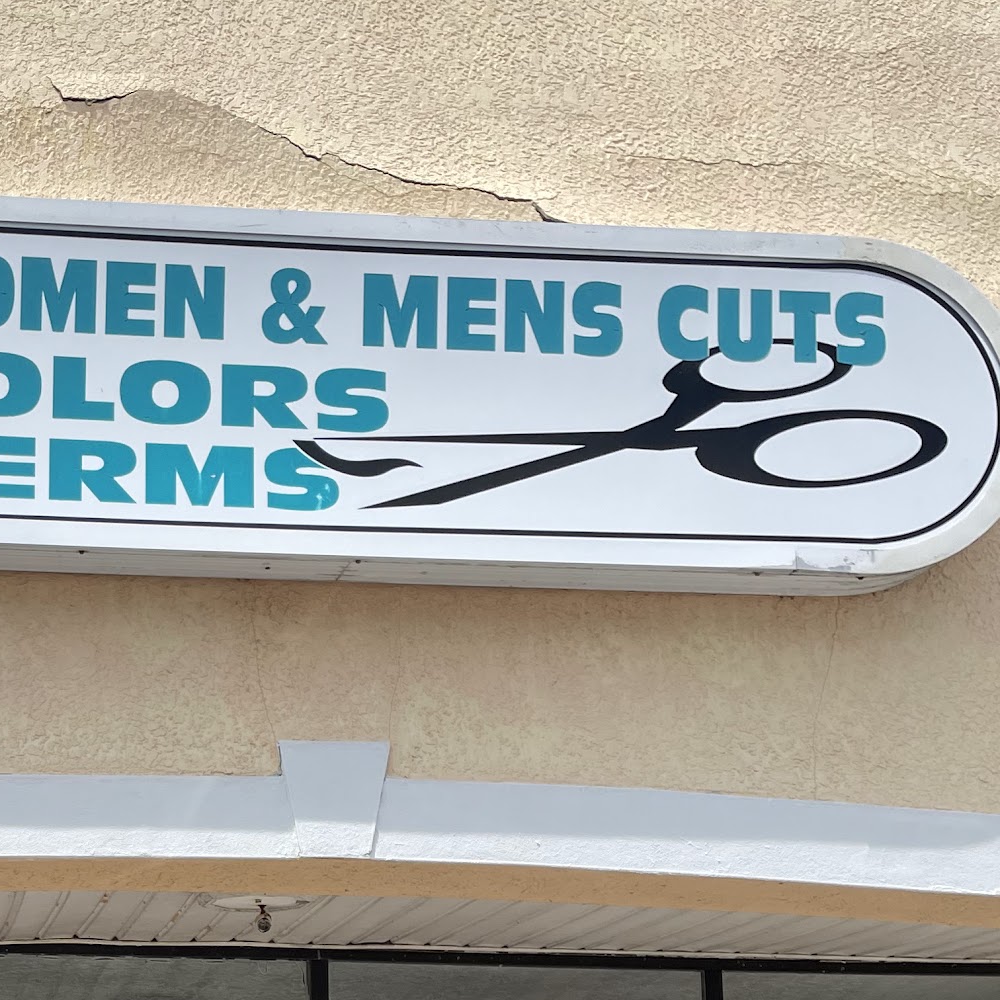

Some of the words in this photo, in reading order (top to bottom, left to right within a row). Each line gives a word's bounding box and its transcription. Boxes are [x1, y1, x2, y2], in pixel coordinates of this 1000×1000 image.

[261, 267, 327, 345] &
[361, 273, 622, 356] MENS
[658, 284, 887, 366] CUTS
